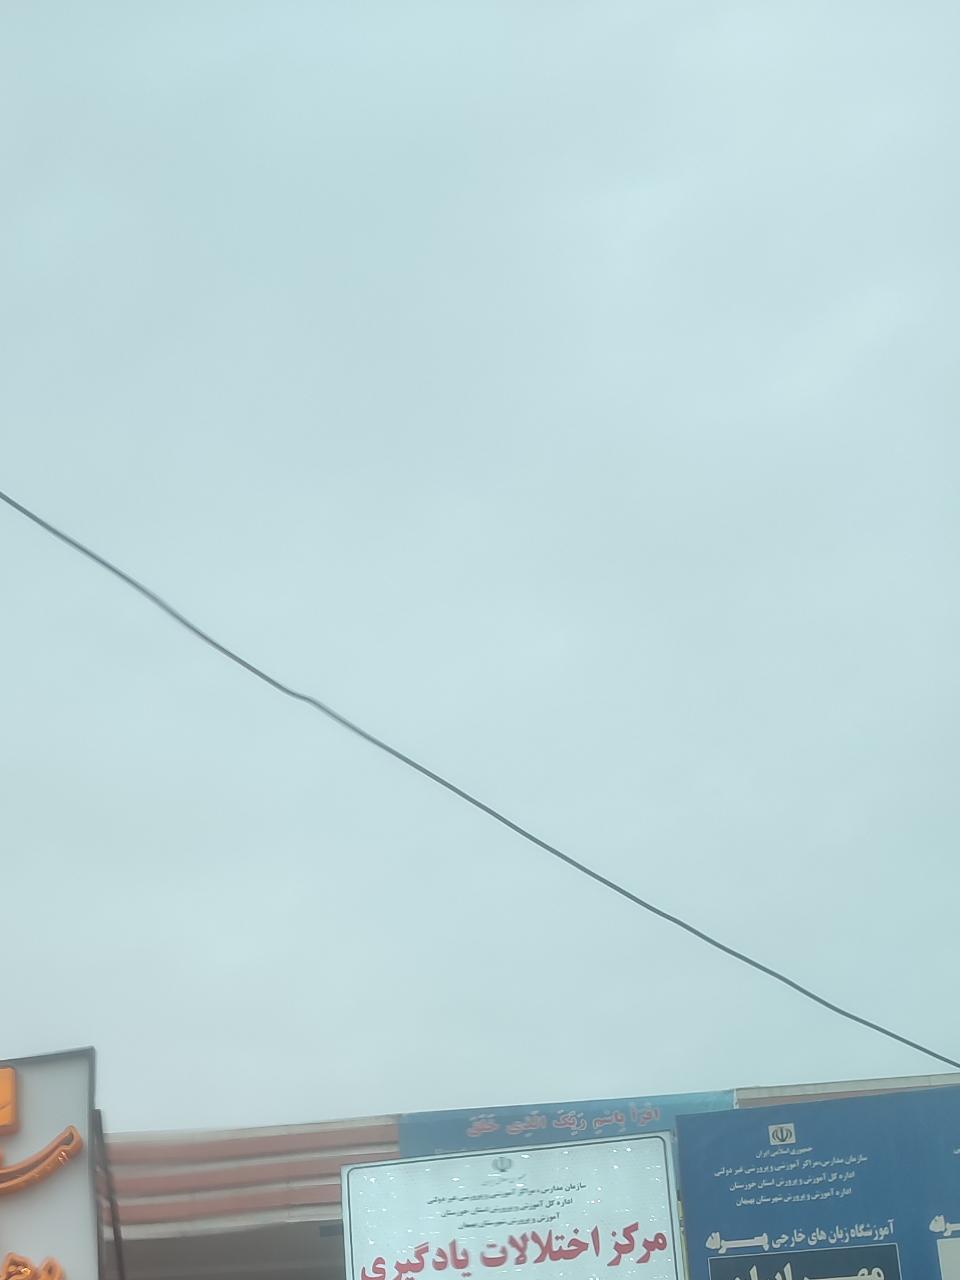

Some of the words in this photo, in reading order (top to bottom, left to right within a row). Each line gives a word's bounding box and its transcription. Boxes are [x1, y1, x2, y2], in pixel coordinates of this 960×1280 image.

[564, 1181, 587, 1192] سازمان
[828, 1172, 838, 1182] کل
[771, 1228, 806, 1249] خارجی
[807, 1227, 827, 1246] های
[828, 1225, 850, 1244] زبان
[850, 1218, 895, 1240] آموزشگاه
[480, 1225, 601, 1268] اختلالات
[607, 1221, 668, 1267] مرکز
